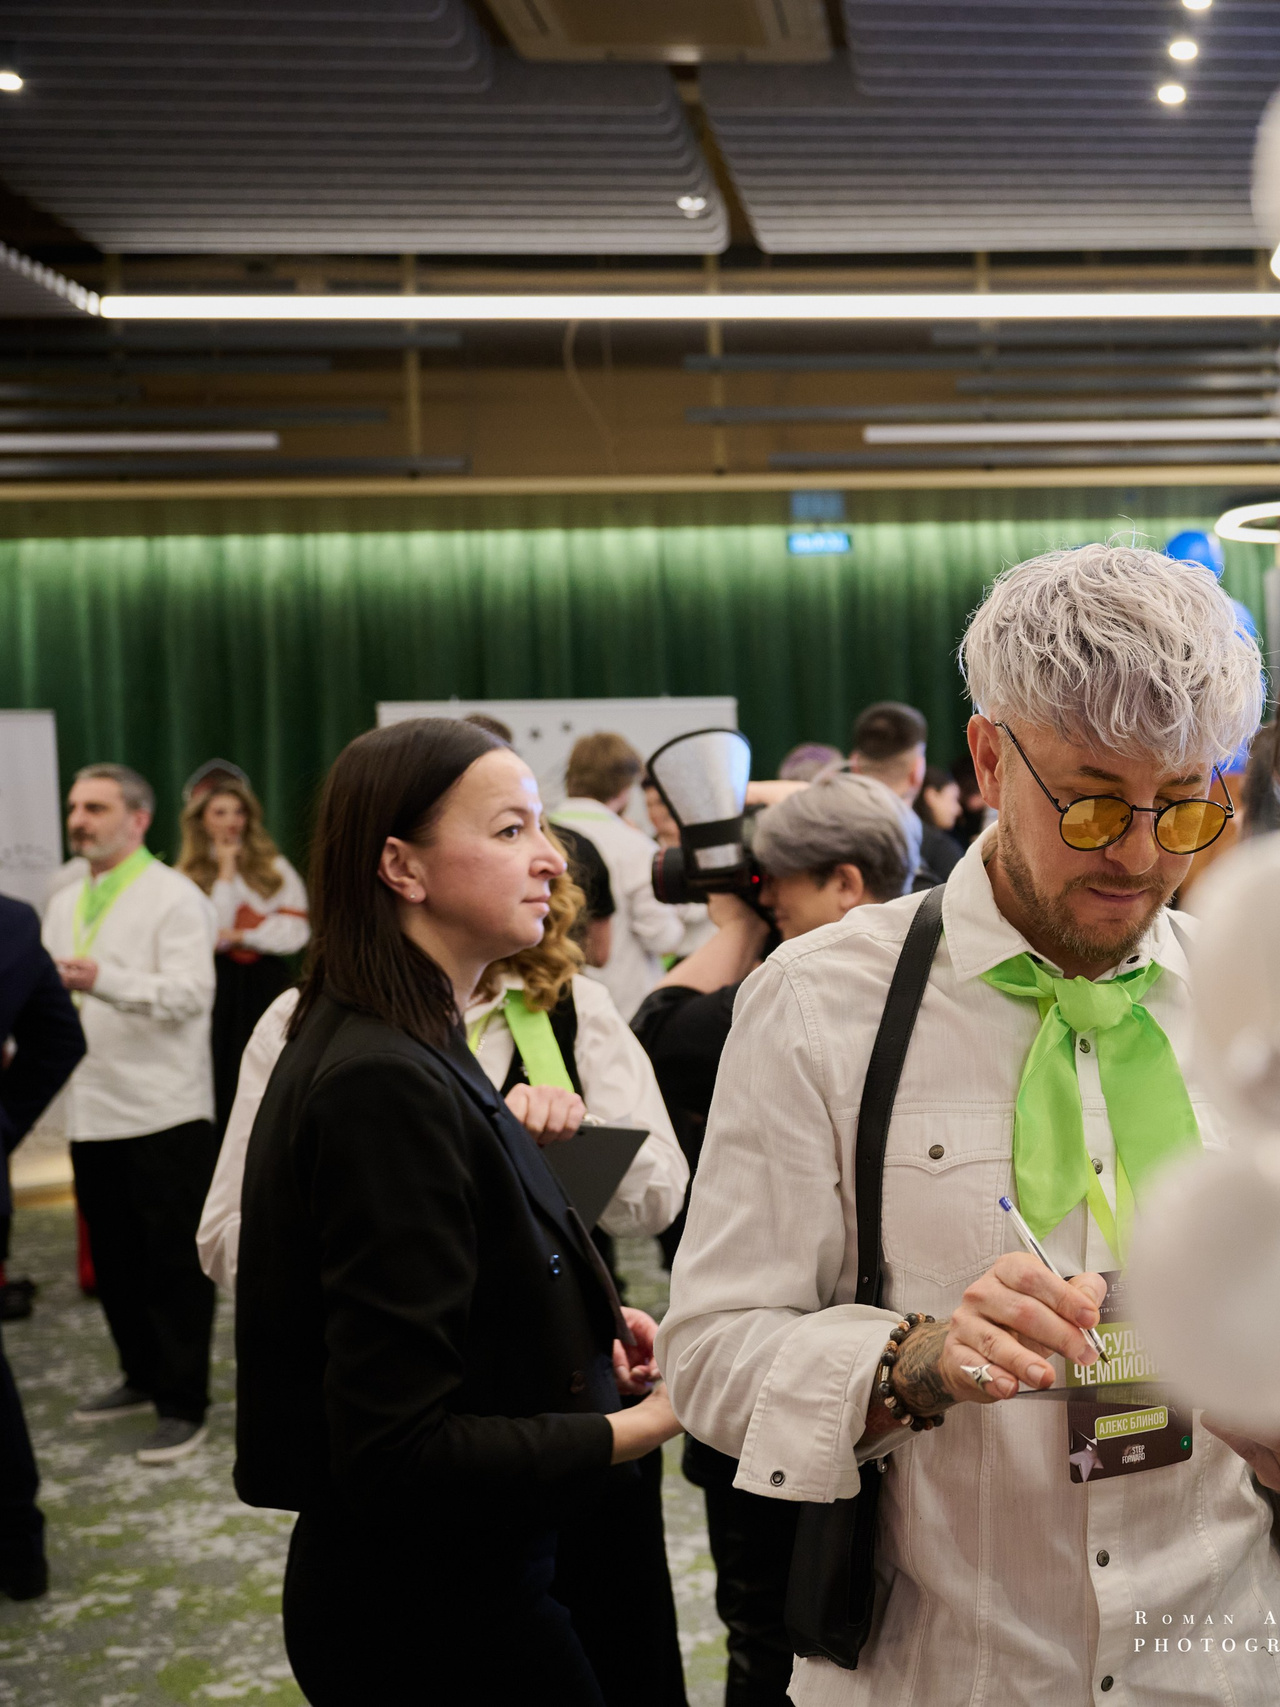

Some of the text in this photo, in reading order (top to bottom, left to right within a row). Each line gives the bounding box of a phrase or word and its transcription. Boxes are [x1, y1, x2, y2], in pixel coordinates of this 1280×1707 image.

[1099, 1411, 1165, 1435] АЛЕКС БЛИНОВ
[1132, 1445, 1145, 1455] STEP
[1121, 1452, 1146, 1465] FORWARD
